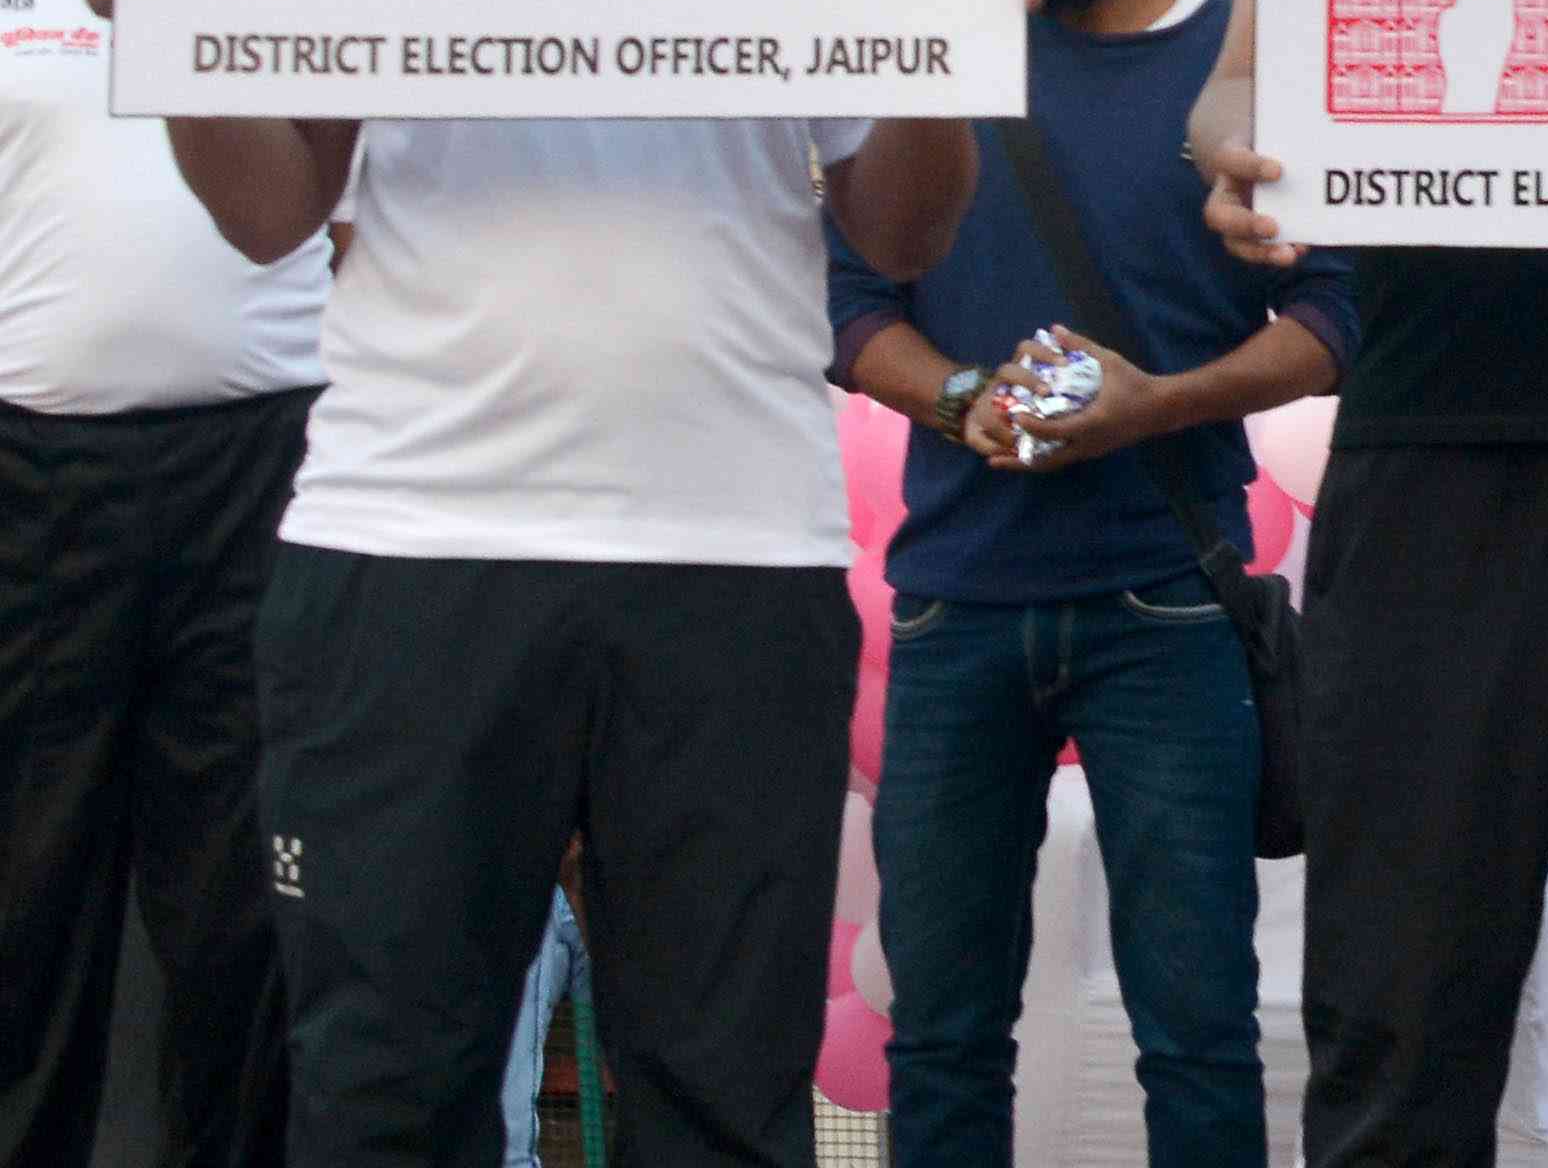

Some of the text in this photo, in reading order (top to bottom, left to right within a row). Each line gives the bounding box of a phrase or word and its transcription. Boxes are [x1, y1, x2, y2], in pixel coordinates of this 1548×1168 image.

[194, 34, 951, 80] DISTRICT ELECTION OFFICER, JAIPUR
[1325, 168, 1499, 207] DISTRICT
